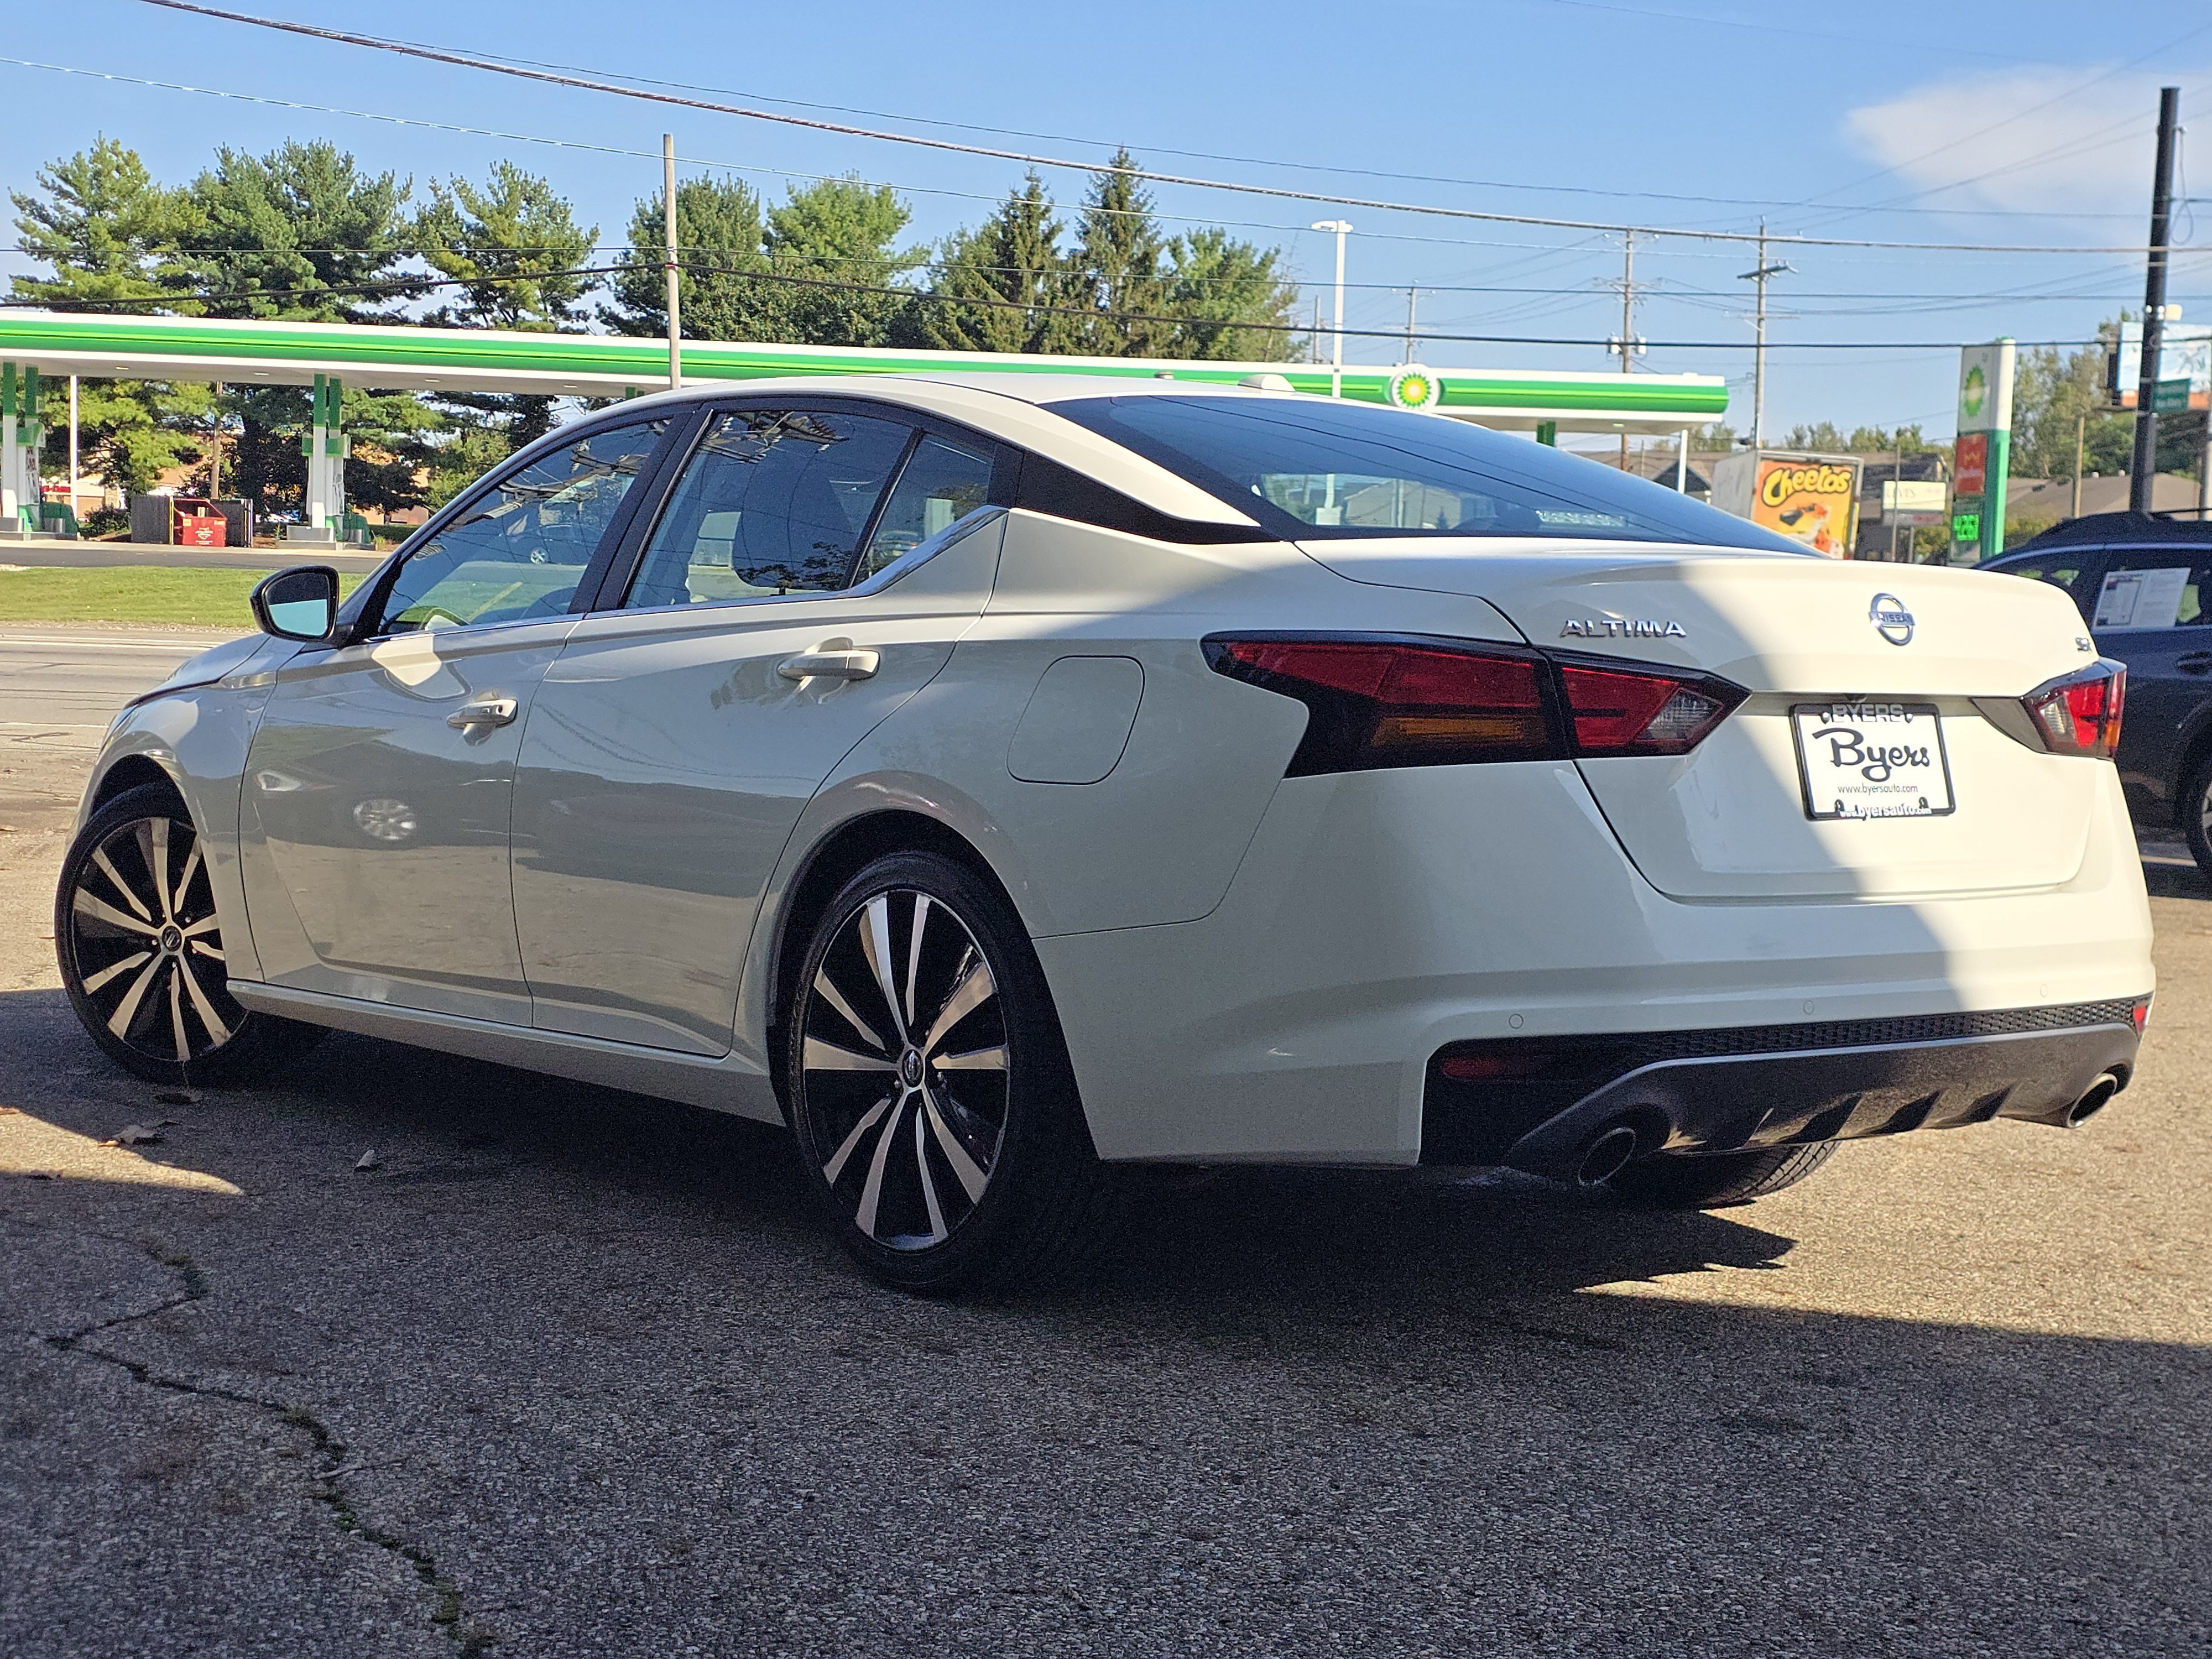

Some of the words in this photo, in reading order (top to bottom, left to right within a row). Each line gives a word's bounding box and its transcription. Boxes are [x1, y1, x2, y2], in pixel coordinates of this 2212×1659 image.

[1762, 463, 1853, 508] Cheetos
[1560, 619, 1687, 638] ALTIMA
[1831, 703, 1905, 723] BYERS
[1811, 727, 1931, 782] Byers
[1837, 783, 1918, 796] www.byersauto.com
